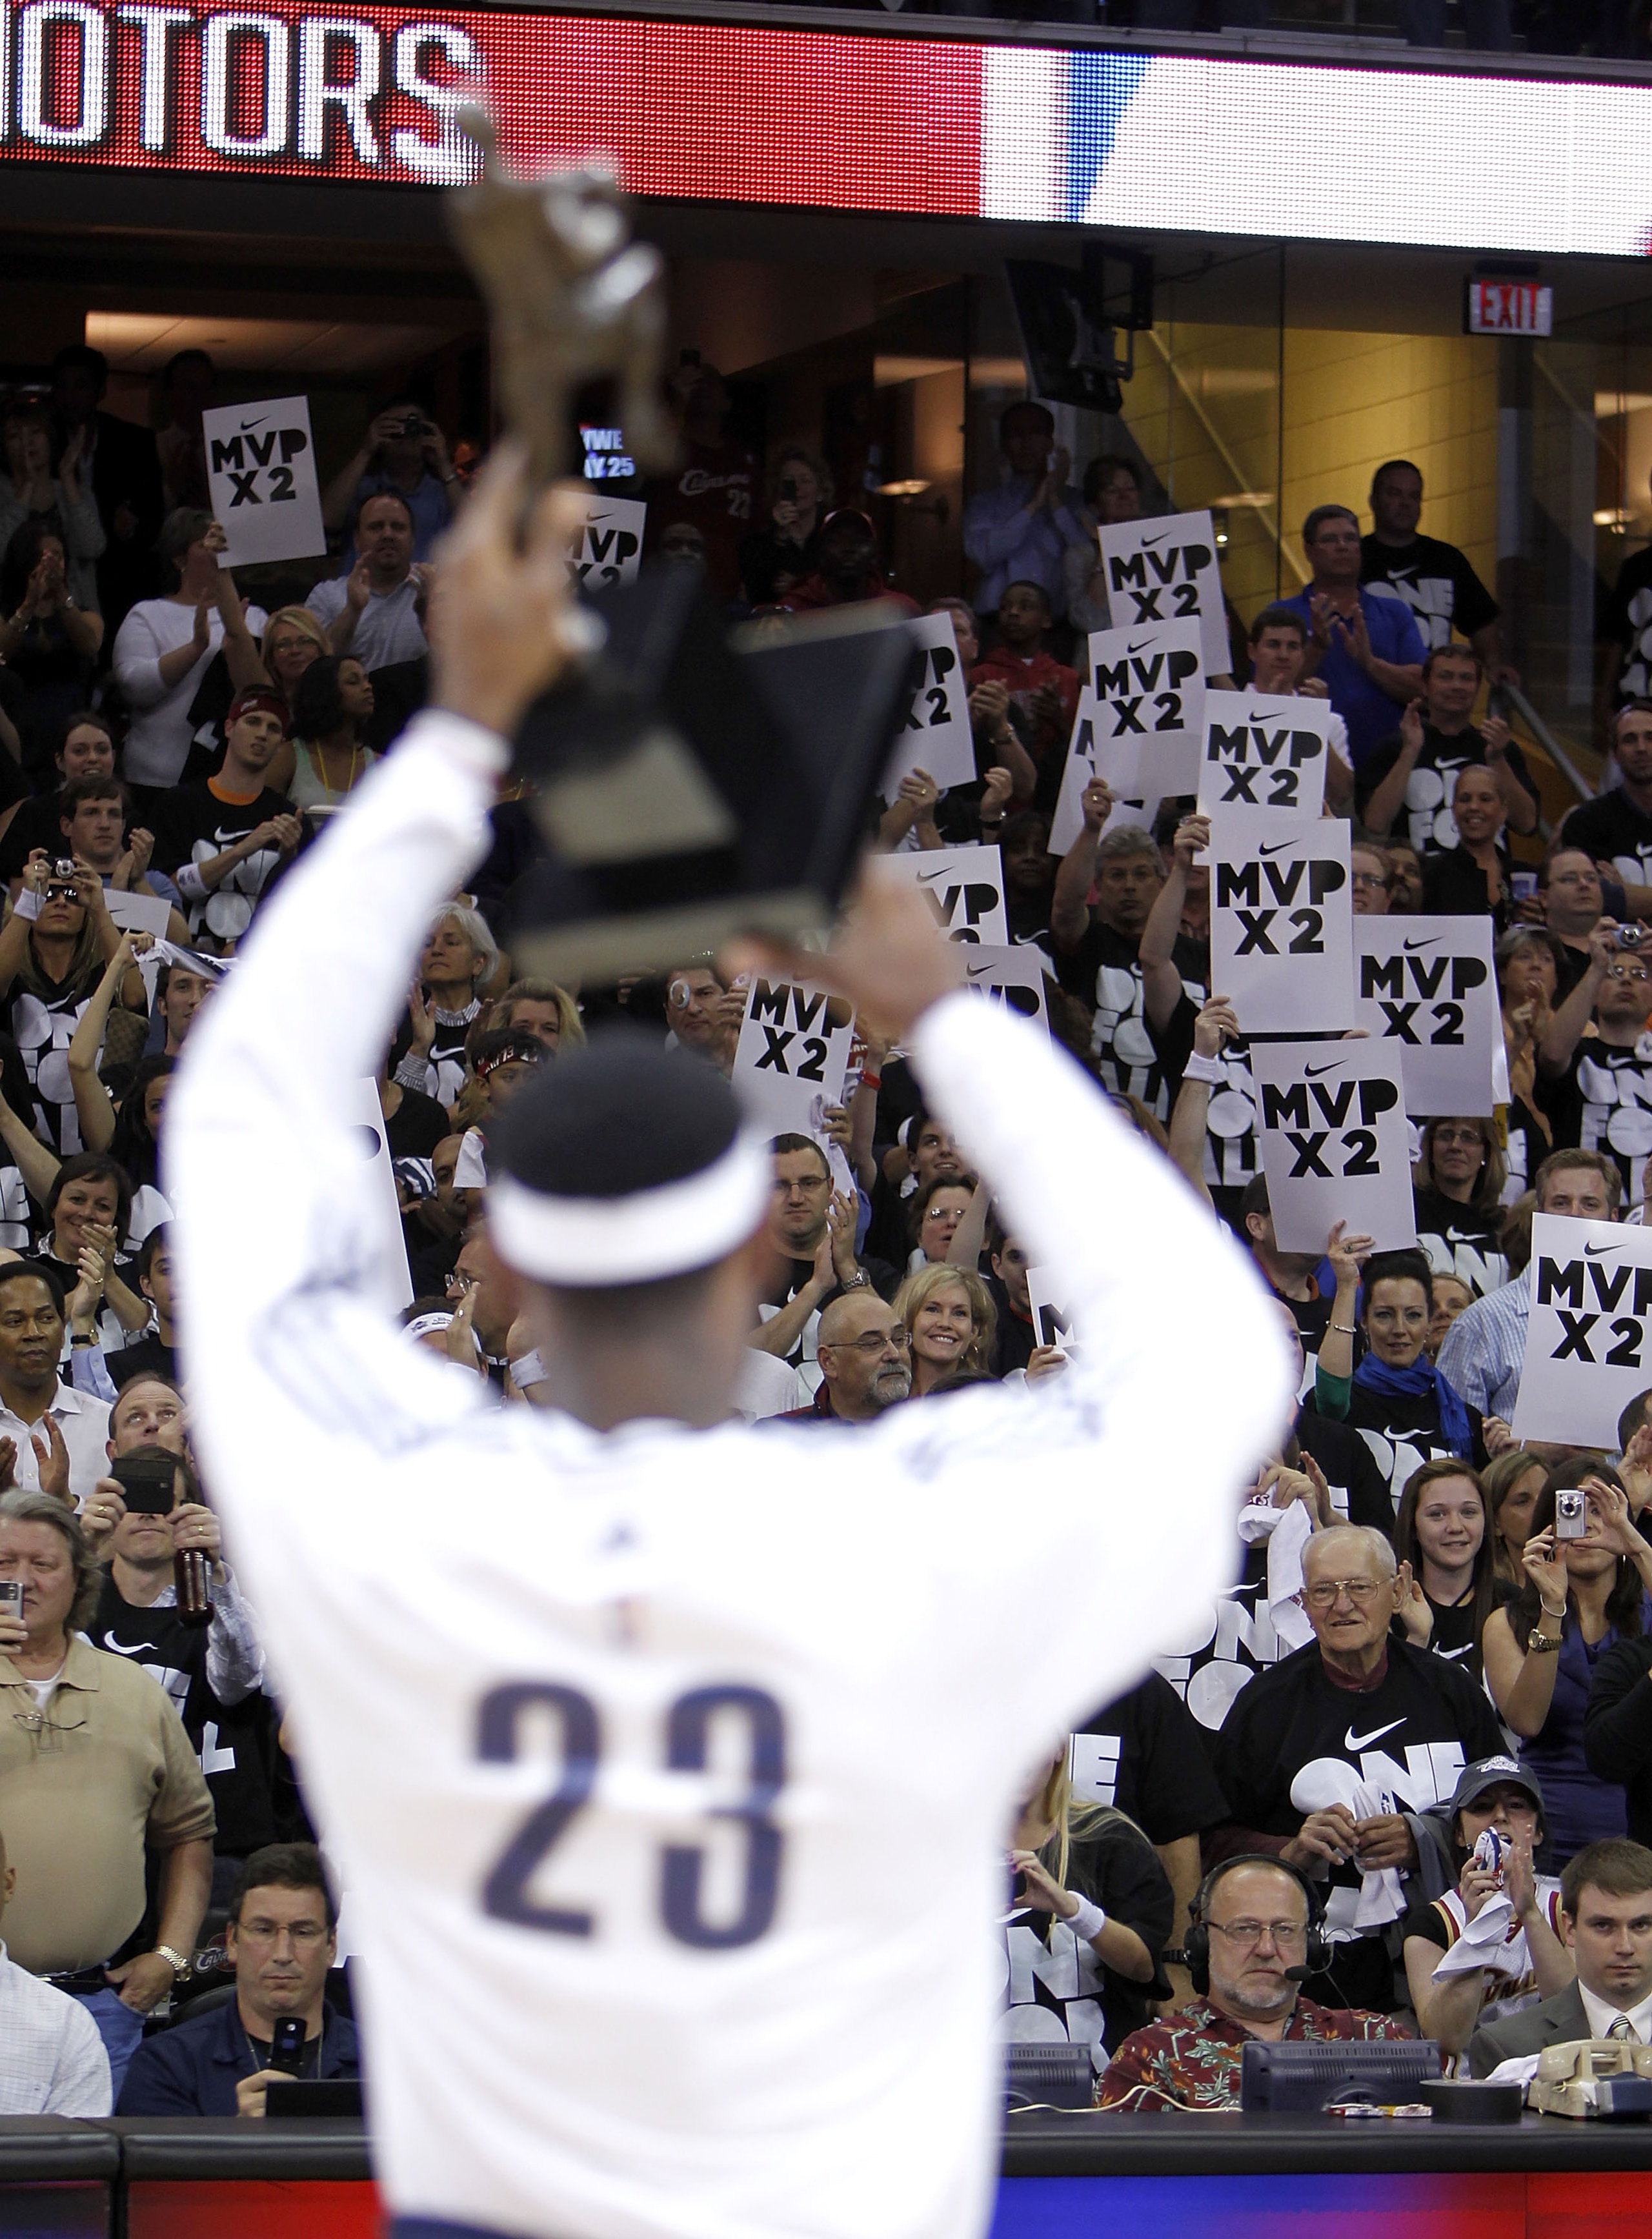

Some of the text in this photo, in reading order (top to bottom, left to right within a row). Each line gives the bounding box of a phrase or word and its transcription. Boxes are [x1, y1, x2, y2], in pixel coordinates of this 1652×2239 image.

[0, 0, 487, 186] OTORS
[1480, 280, 1541, 330] EXIT
[210, 429, 307, 473] MVP
[607, 456, 636, 477] 25
[1109, 544, 1211, 591] MVP
[1095, 650, 1198, 701] MVP
[1207, 723, 1322, 768] MVP
[1217, 860, 1346, 908] MVP
[1360, 955, 1487, 999] MVP
[750, 978, 853, 1038] MVP
[1261, 1079, 1398, 1130] MVP
[476, 1680, 791, 1952] 23
